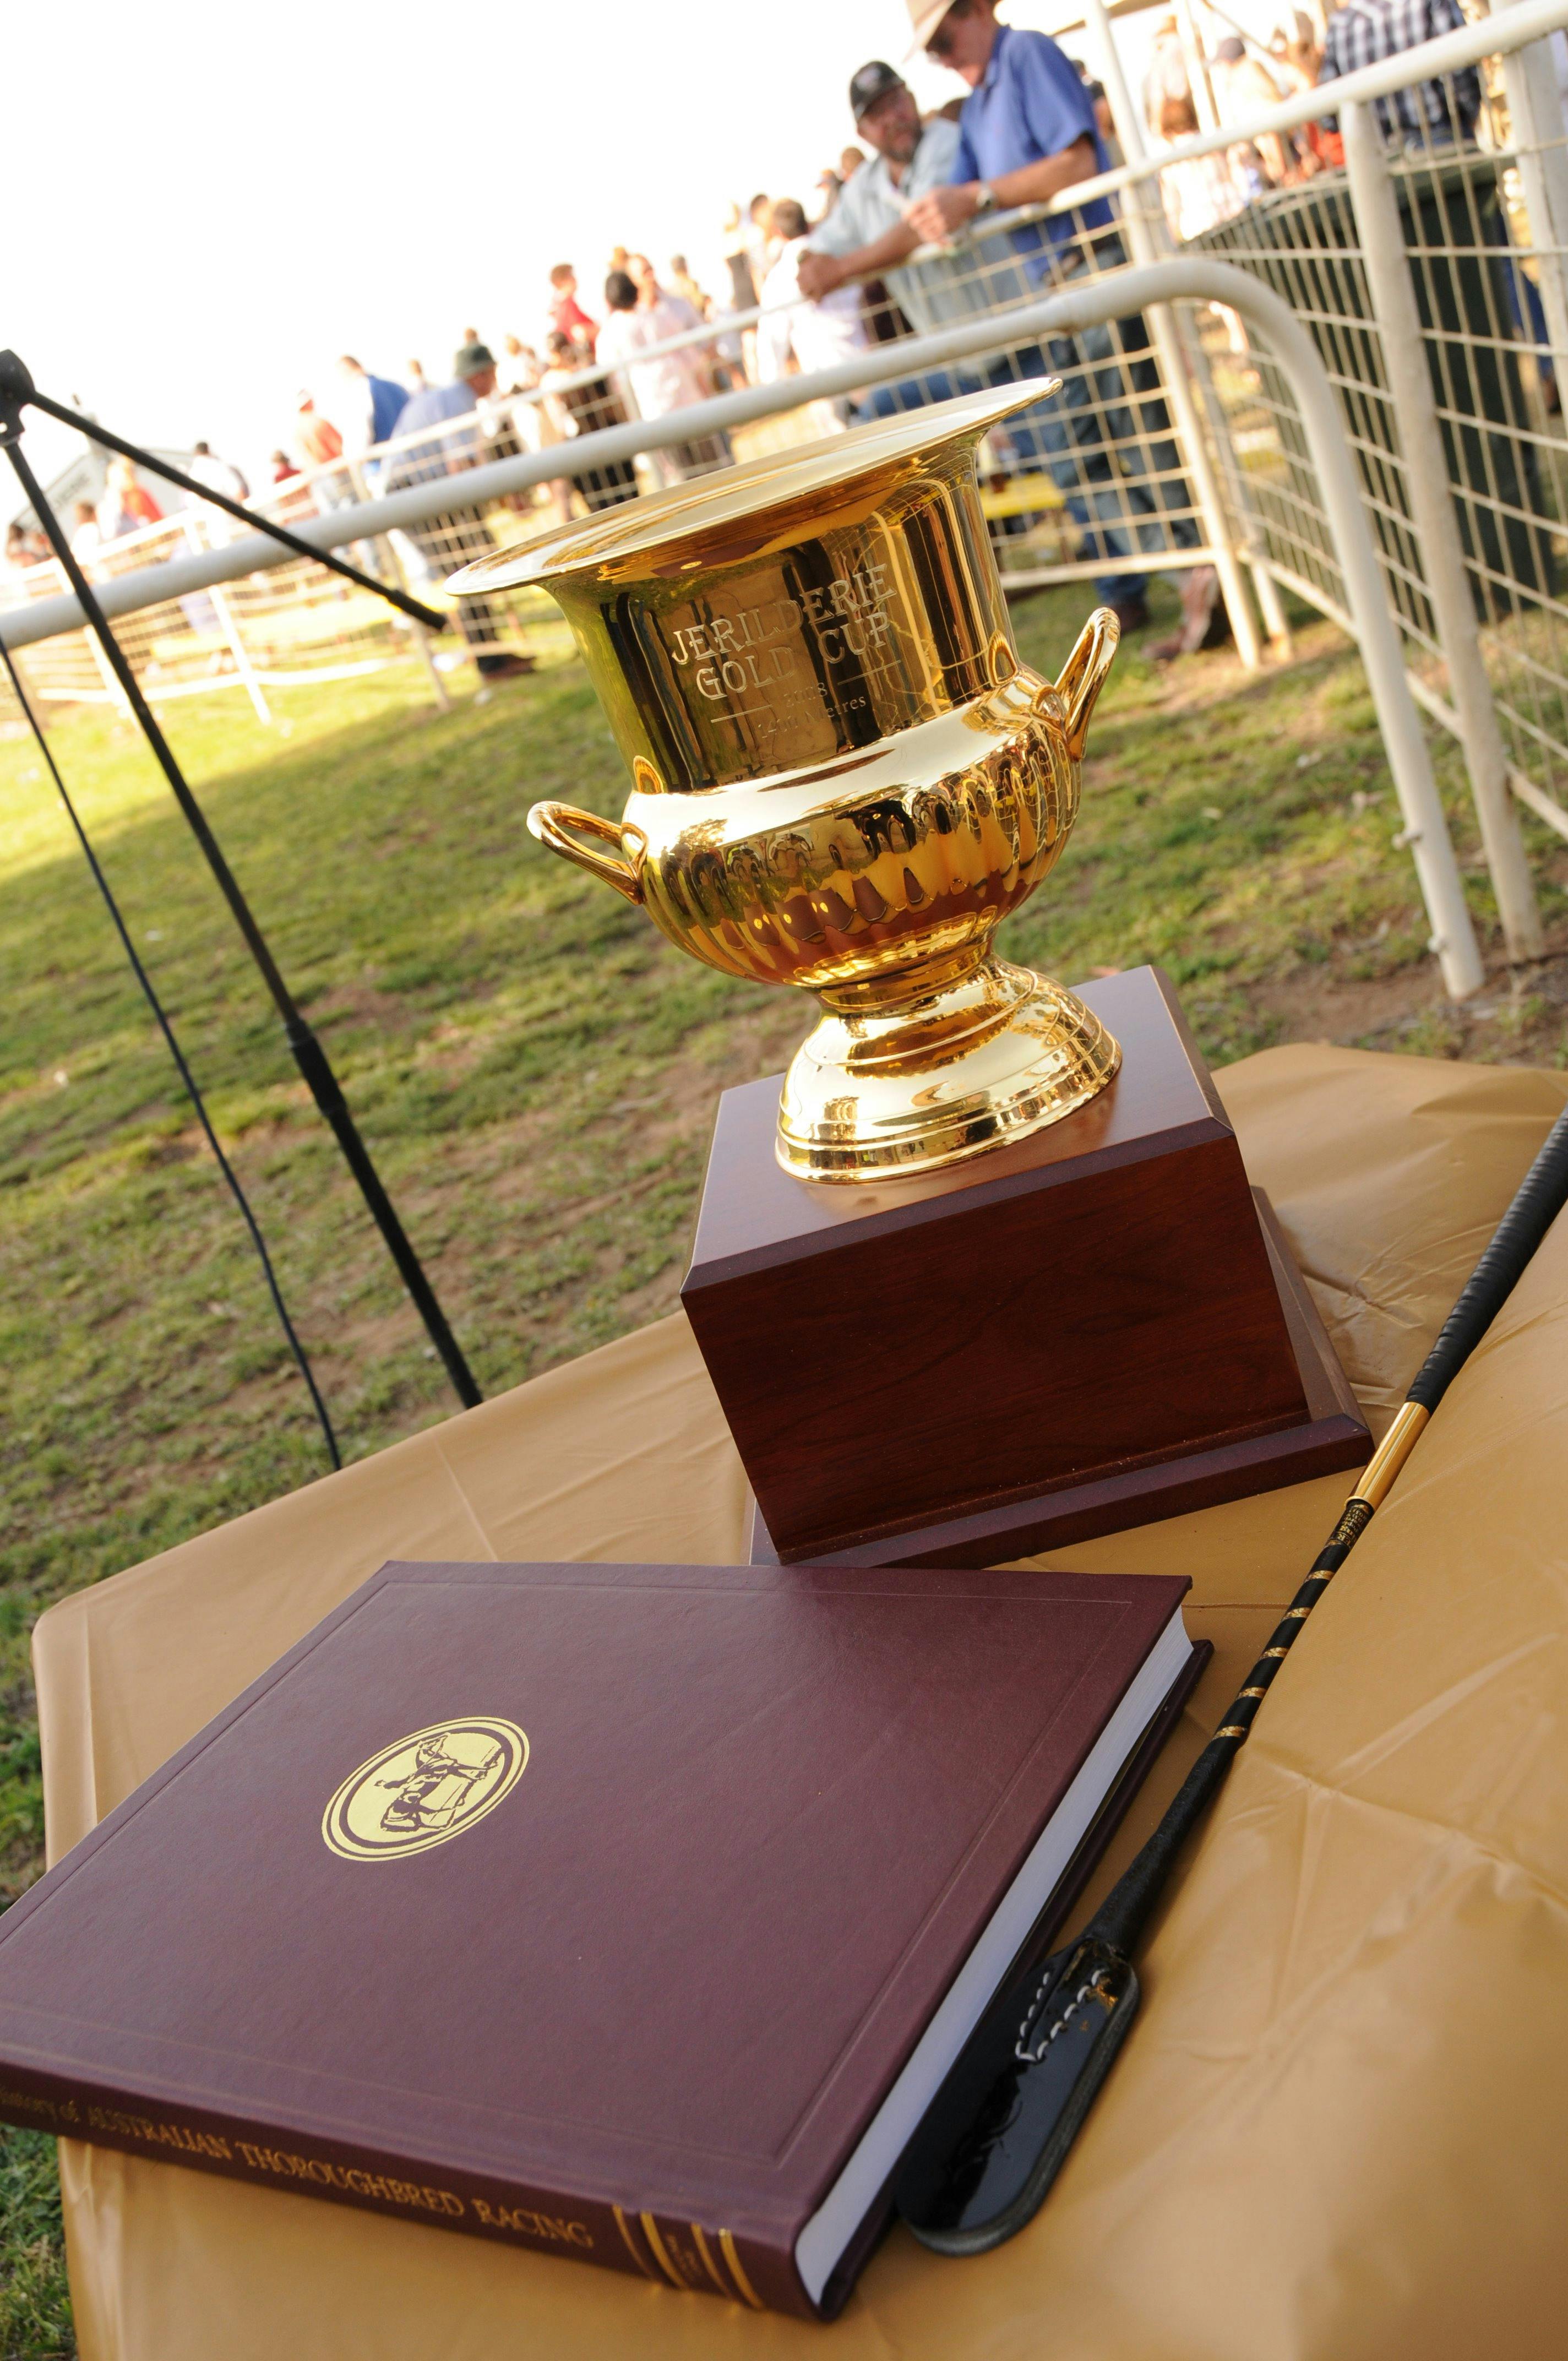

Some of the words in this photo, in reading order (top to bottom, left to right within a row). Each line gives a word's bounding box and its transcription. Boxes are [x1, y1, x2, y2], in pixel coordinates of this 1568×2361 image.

[671, 563, 897, 665] JERILDERIE
[696, 645, 797, 700] GOLD
[818, 611, 892, 664] CUP
[235, 2140, 465, 2218] THOROUGHBRED
[471, 2197, 594, 2248] RACING
